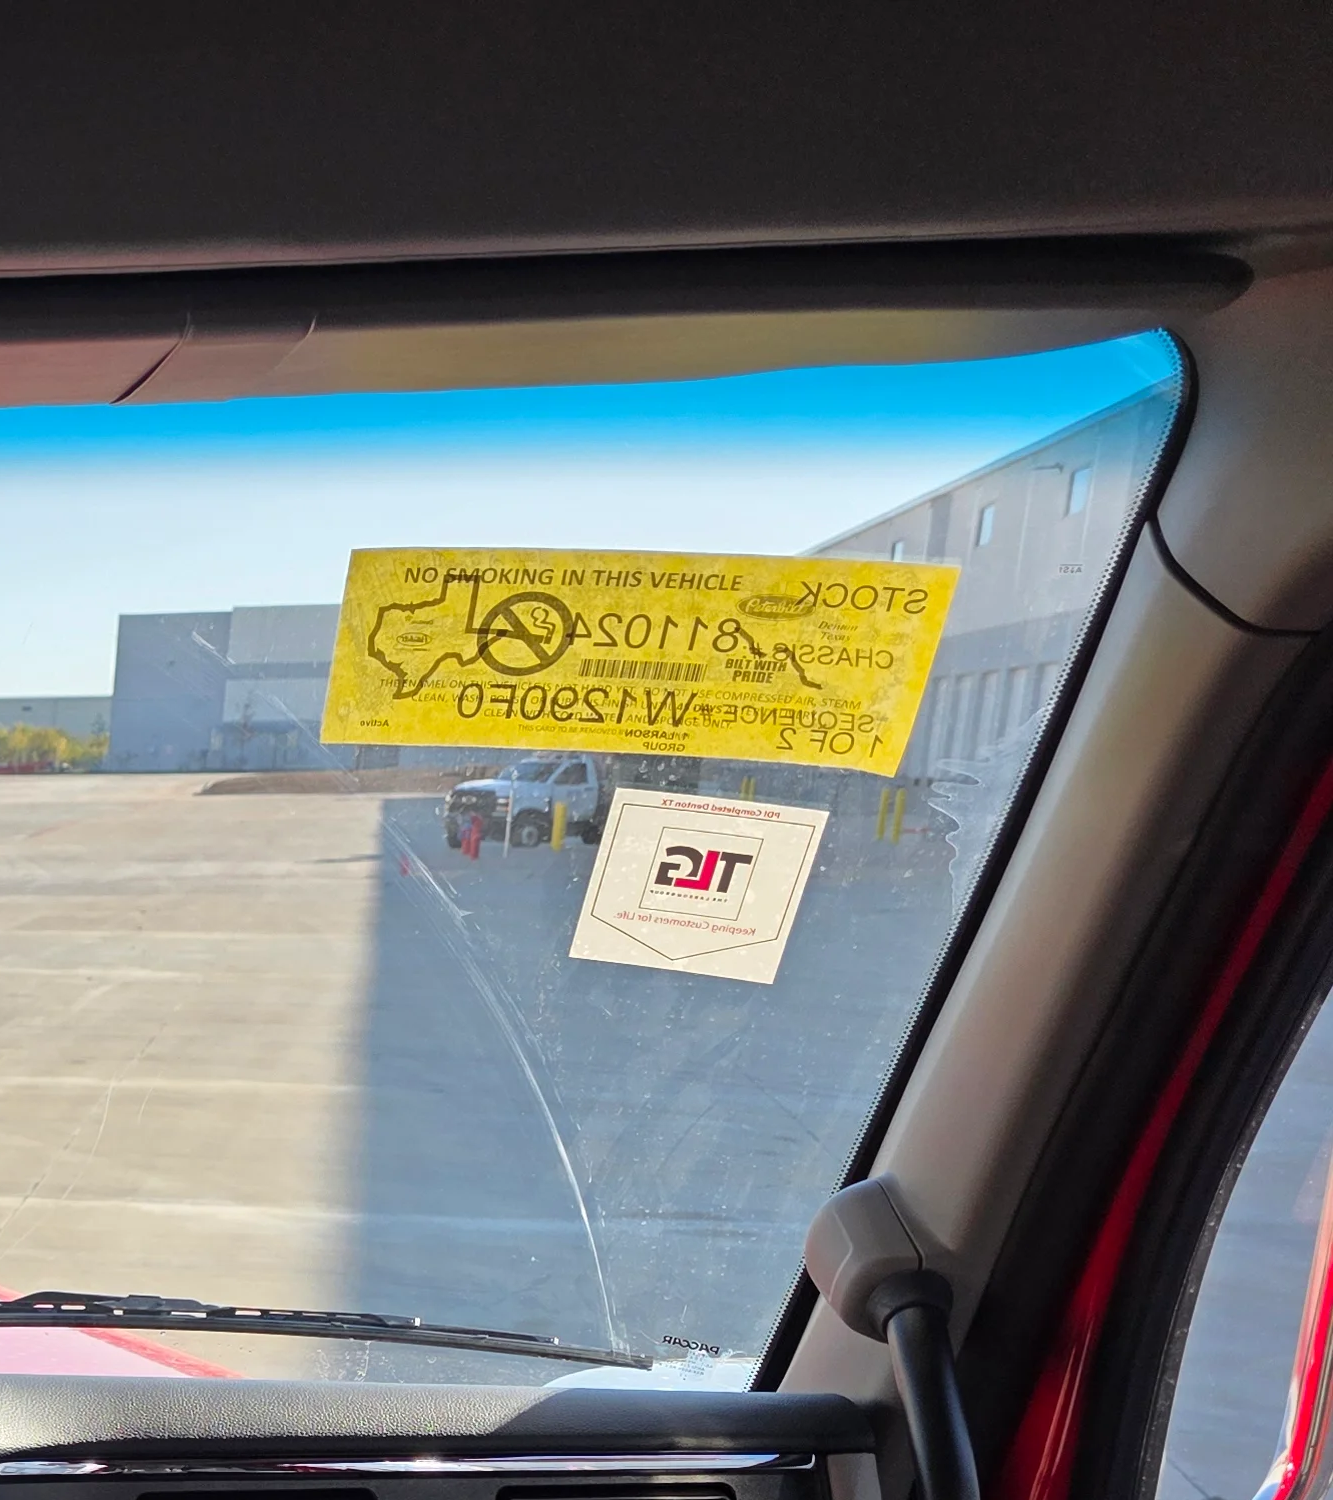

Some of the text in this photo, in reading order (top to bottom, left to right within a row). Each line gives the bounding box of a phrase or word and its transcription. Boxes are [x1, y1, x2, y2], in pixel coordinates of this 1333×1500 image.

[404, 567, 744, 591] NO SMOKING IN THIS VEHICLE
[725, 658, 787, 672] BILT WITH
[732, 670, 773, 684] PRIDE
[714, 690, 793, 704] COMPRESSED
[822, 699, 862, 710] STEAM
